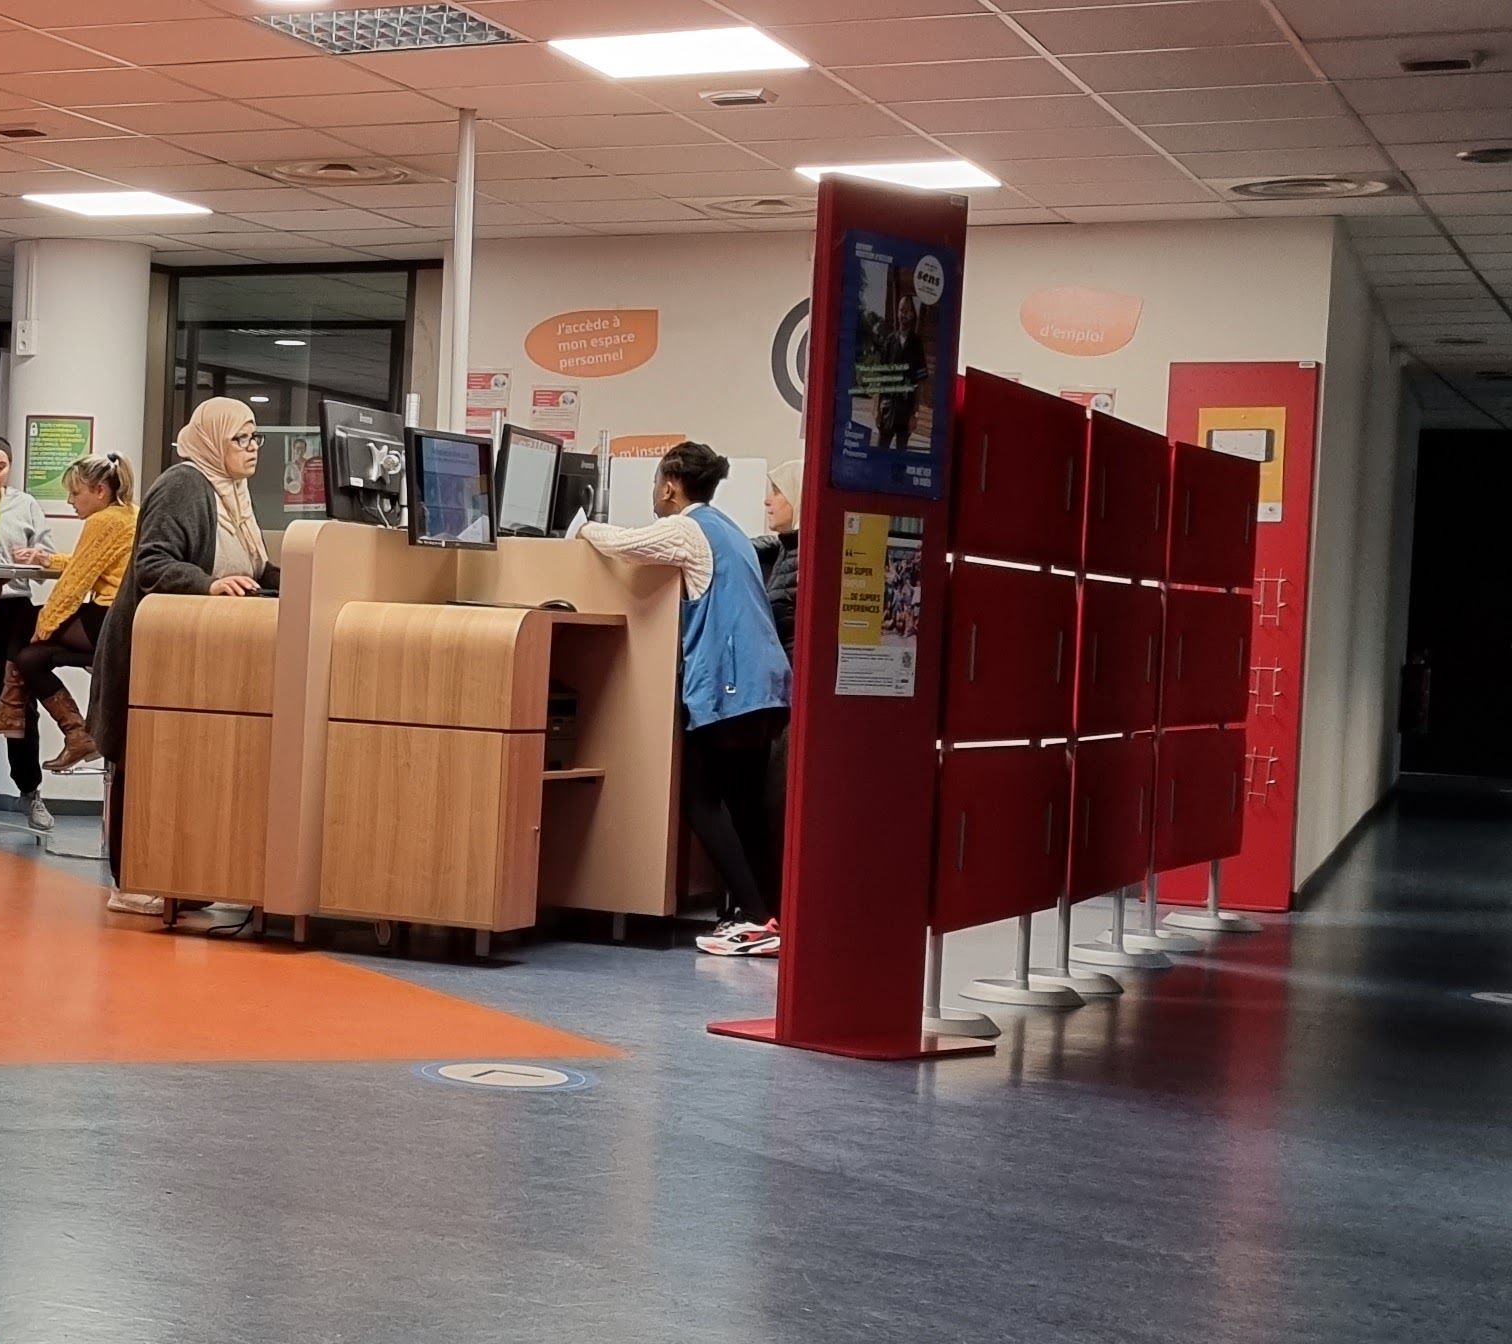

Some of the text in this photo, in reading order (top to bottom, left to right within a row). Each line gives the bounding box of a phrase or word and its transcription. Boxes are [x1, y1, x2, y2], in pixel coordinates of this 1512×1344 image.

[917, 271, 940, 287] sens
[557, 316, 620, 335] J'accède à
[1040, 323, 1104, 343] d'emploi
[558, 332, 635, 352] mon espace
[559, 349, 623, 371] personnel
[619, 442, 672, 458] m'inscri
